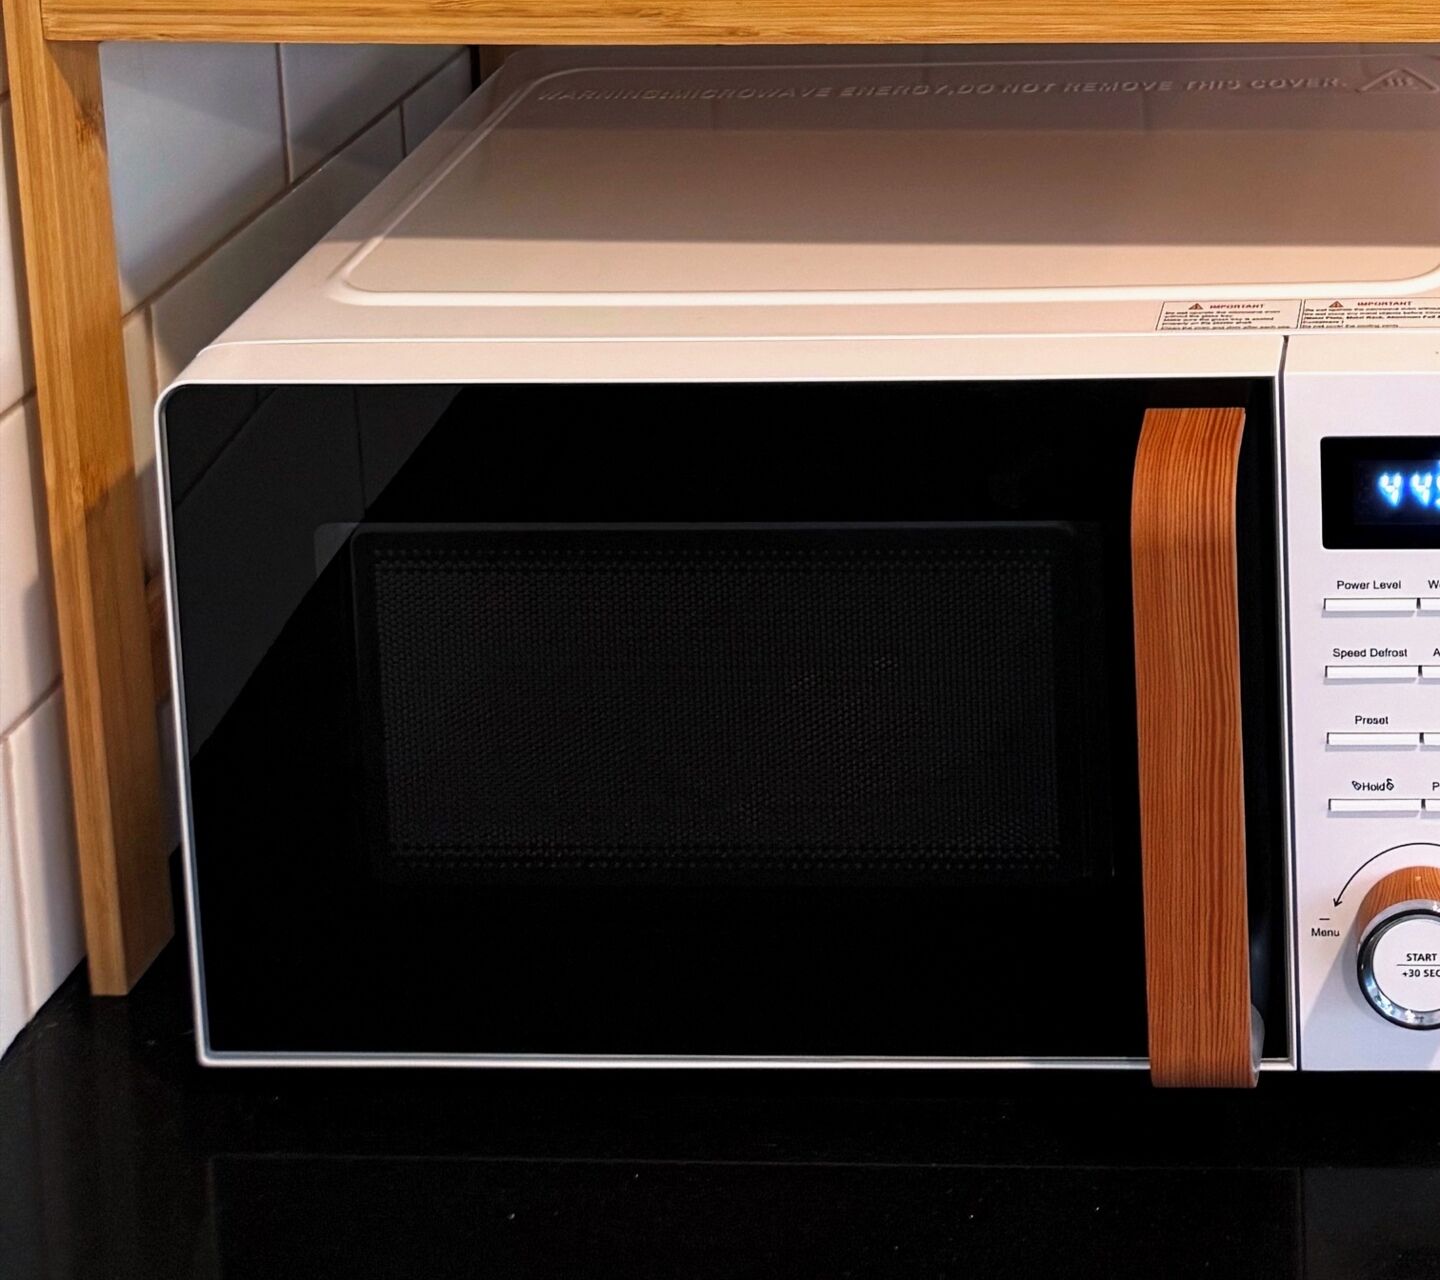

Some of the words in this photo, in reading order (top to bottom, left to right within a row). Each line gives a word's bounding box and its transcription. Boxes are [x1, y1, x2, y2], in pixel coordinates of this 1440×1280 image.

[1063, 81, 1173, 93] REMOVE
[1337, 580, 1370, 590] Power
[1373, 580, 1402, 590] Level
[1332, 647, 1367, 660] Speed
[1370, 647, 1408, 658] Defrost
[1354, 715, 1389, 725] Preset
[1362, 782, 1386, 792] Hold
[1311, 927, 1341, 938] Menu
[1406, 952, 1438, 962] START
[1402, 968, 1421, 978] +30
